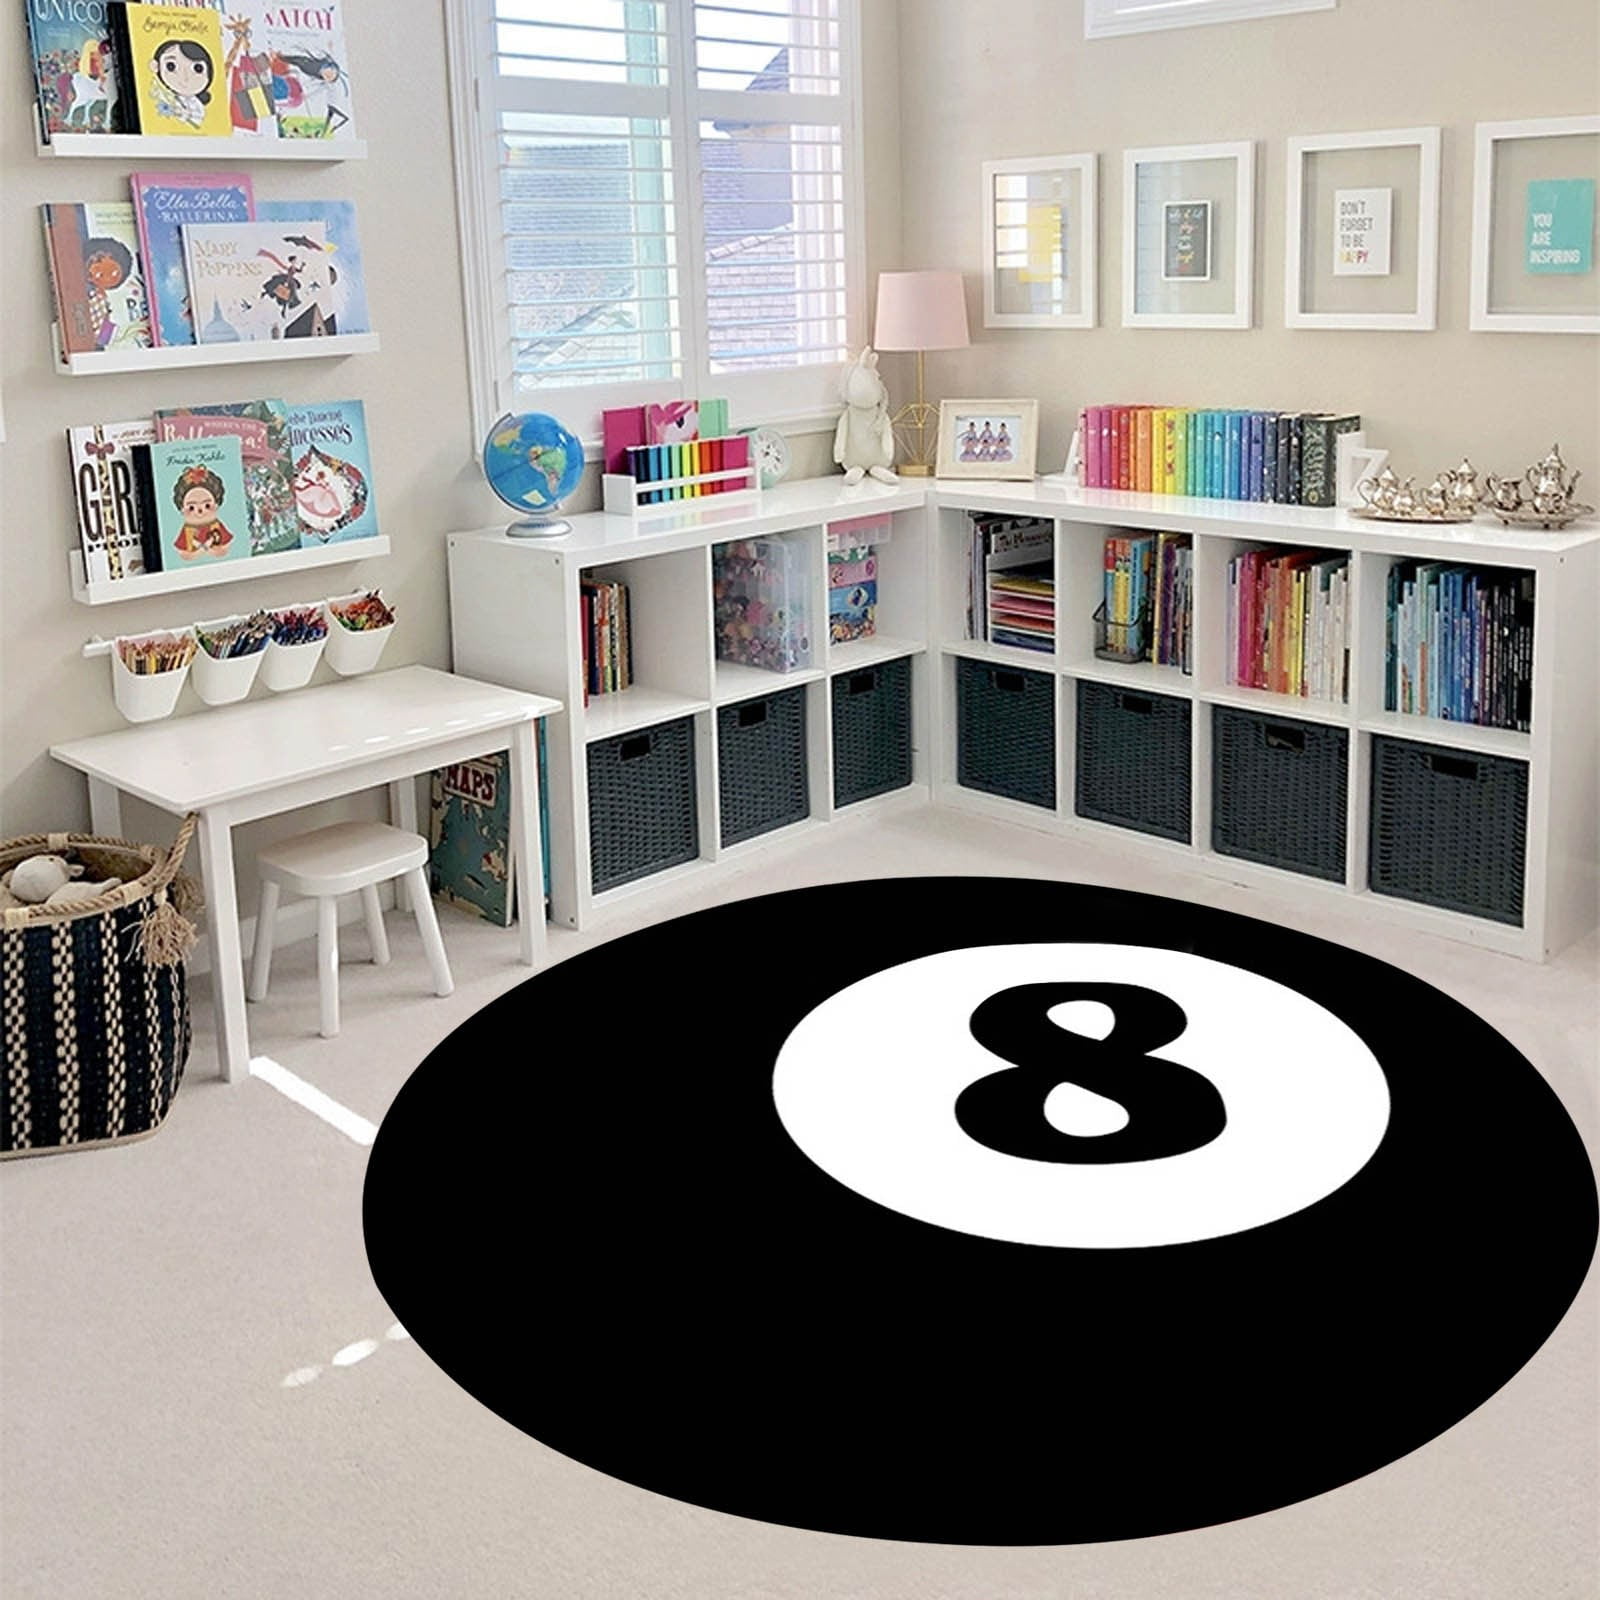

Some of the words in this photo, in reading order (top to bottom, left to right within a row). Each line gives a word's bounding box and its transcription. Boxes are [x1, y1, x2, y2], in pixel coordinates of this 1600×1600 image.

[35, 0, 108, 23] UNICO
[153, 191, 189, 210] Ella
[190, 191, 238, 209] Bella
[1341, 201, 1366, 215] DON'T
[1341, 217, 1373, 231] FORGET
[1532, 213, 1552, 228] YOU
[1341, 233, 1351, 248] TO
[1353, 233, 1365, 248] BE
[1531, 232, 1552, 246] ARE
[1530, 249, 1581, 264] INSPIRING
[288, 424, 353, 446] incesses
[445, 763, 496, 801] MAPS
[954, 981, 1228, 1166] 8
